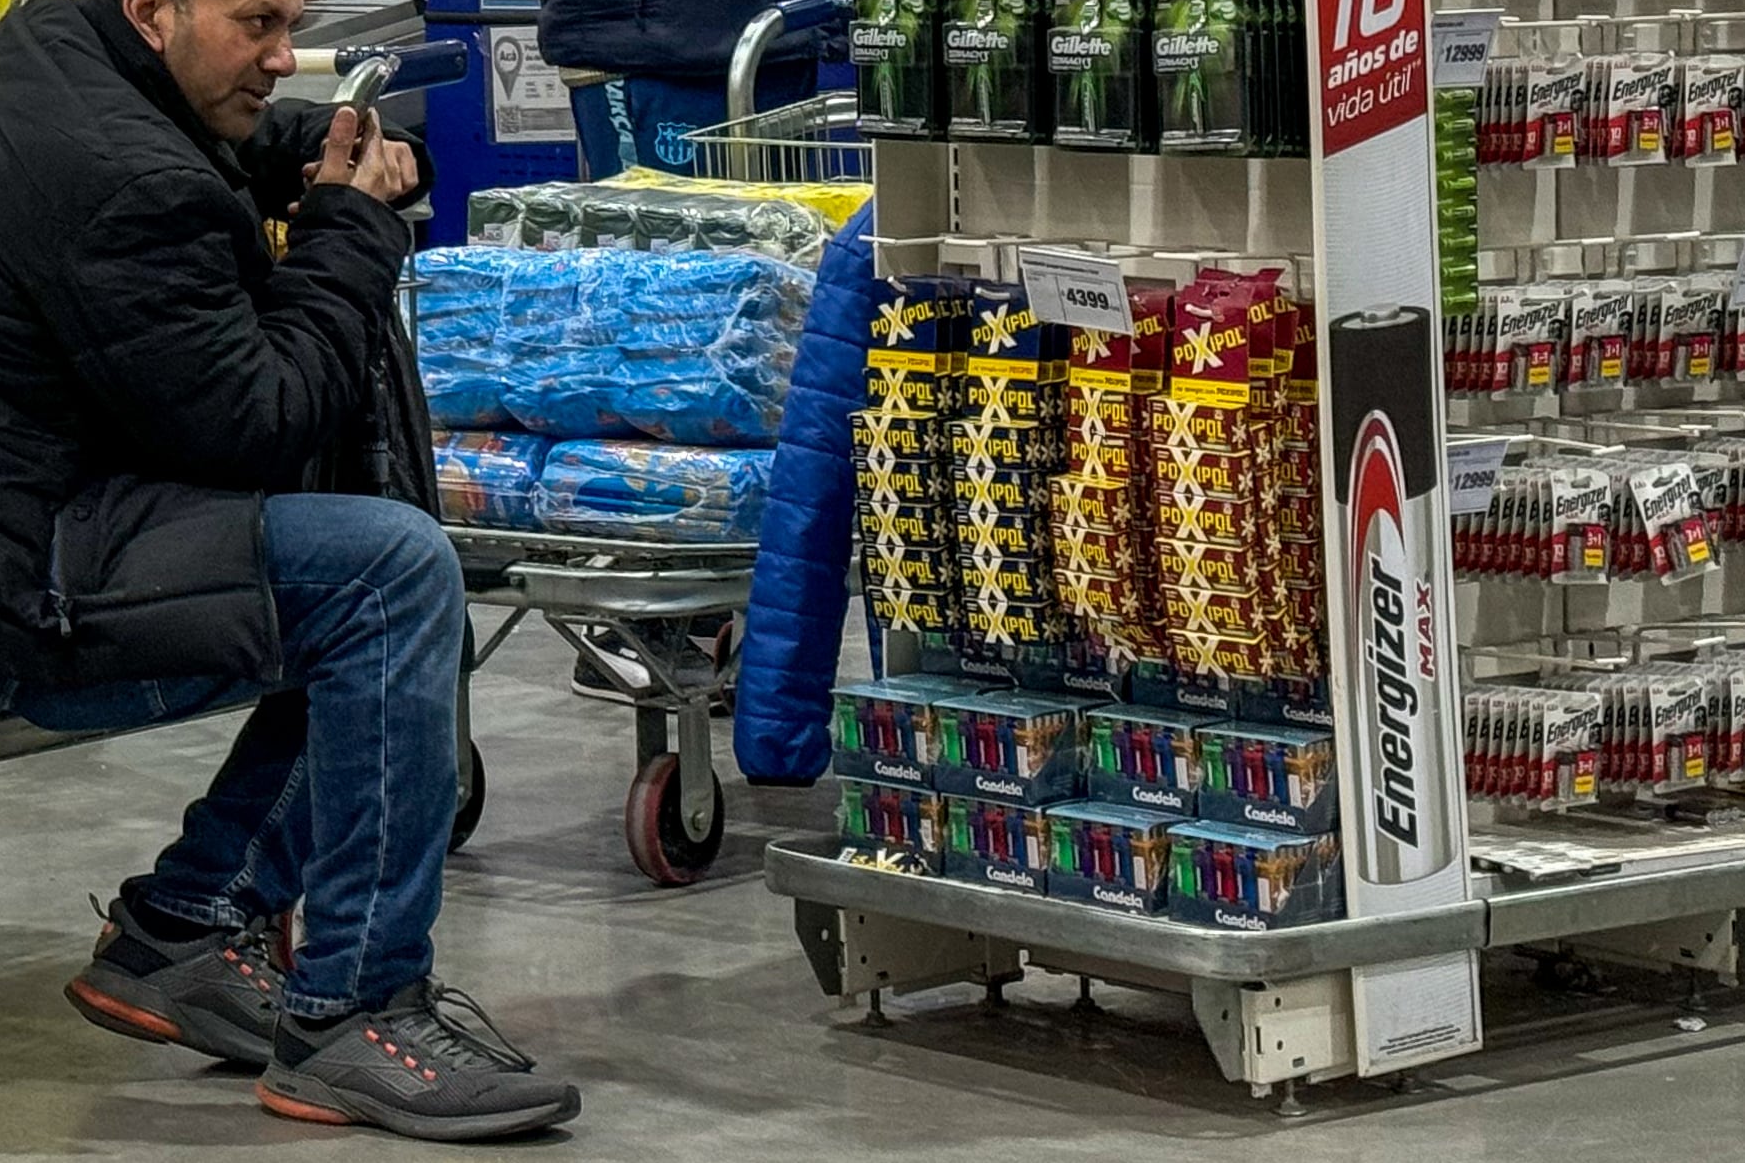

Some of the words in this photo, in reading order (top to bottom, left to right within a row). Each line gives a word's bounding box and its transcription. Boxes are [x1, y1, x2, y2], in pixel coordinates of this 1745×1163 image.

[853, 28, 906, 50] Gillette
[947, 29, 1008, 51] Gillette
[1051, 36, 1112, 56] Gillette
[1157, 36, 1218, 56] Gillette
[1444, 43, 1486, 64] 12999
[1328, 44, 1386, 90] años
[1391, 29, 1418, 58] de
[1529, 71, 1583, 104] Energizer
[1612, 68, 1671, 104] Energizer
[1327, 86, 1373, 127] vida
[1066, 287, 1110, 311] 4399
[1575, 293, 1633, 328] Energizer
[1664, 293, 1722, 326] Energizer
[870, 296, 935, 347] POXIPOL
[1501, 301, 1560, 338] Energizer
[1174, 321, 1246, 375] POXIPOL
[869, 368, 934, 412] POXIPOL
[969, 375, 1036, 423] POXIPOL
[853, 414, 919, 459] POXIPOL
[1153, 400, 1226, 448] POXIPOL
[954, 423, 1022, 469] POXIPOL
[1158, 447, 1232, 495] POXIPOL
[1160, 495, 1235, 539] POXIPOL
[963, 556, 1032, 600] POXIPOL
[1162, 541, 1238, 587] POXIPOL
[873, 588, 942, 632] POXIPOL
[969, 600, 1039, 645] POXIPOL
[1167, 587, 1245, 633] POXIPOL
[1416, 578, 1436, 682] MAX
[1063, 672, 1113, 693] Candela
[1371, 558, 1419, 849] Energizer
[874, 760, 922, 782] Candela
[975, 776, 1023, 798] Candela
[1132, 787, 1182, 808] Candela
[1245, 803, 1296, 827] Candela
[986, 866, 1034, 888] Candela
[1093, 885, 1144, 910] Candela
[1215, 907, 1267, 932] Candela
